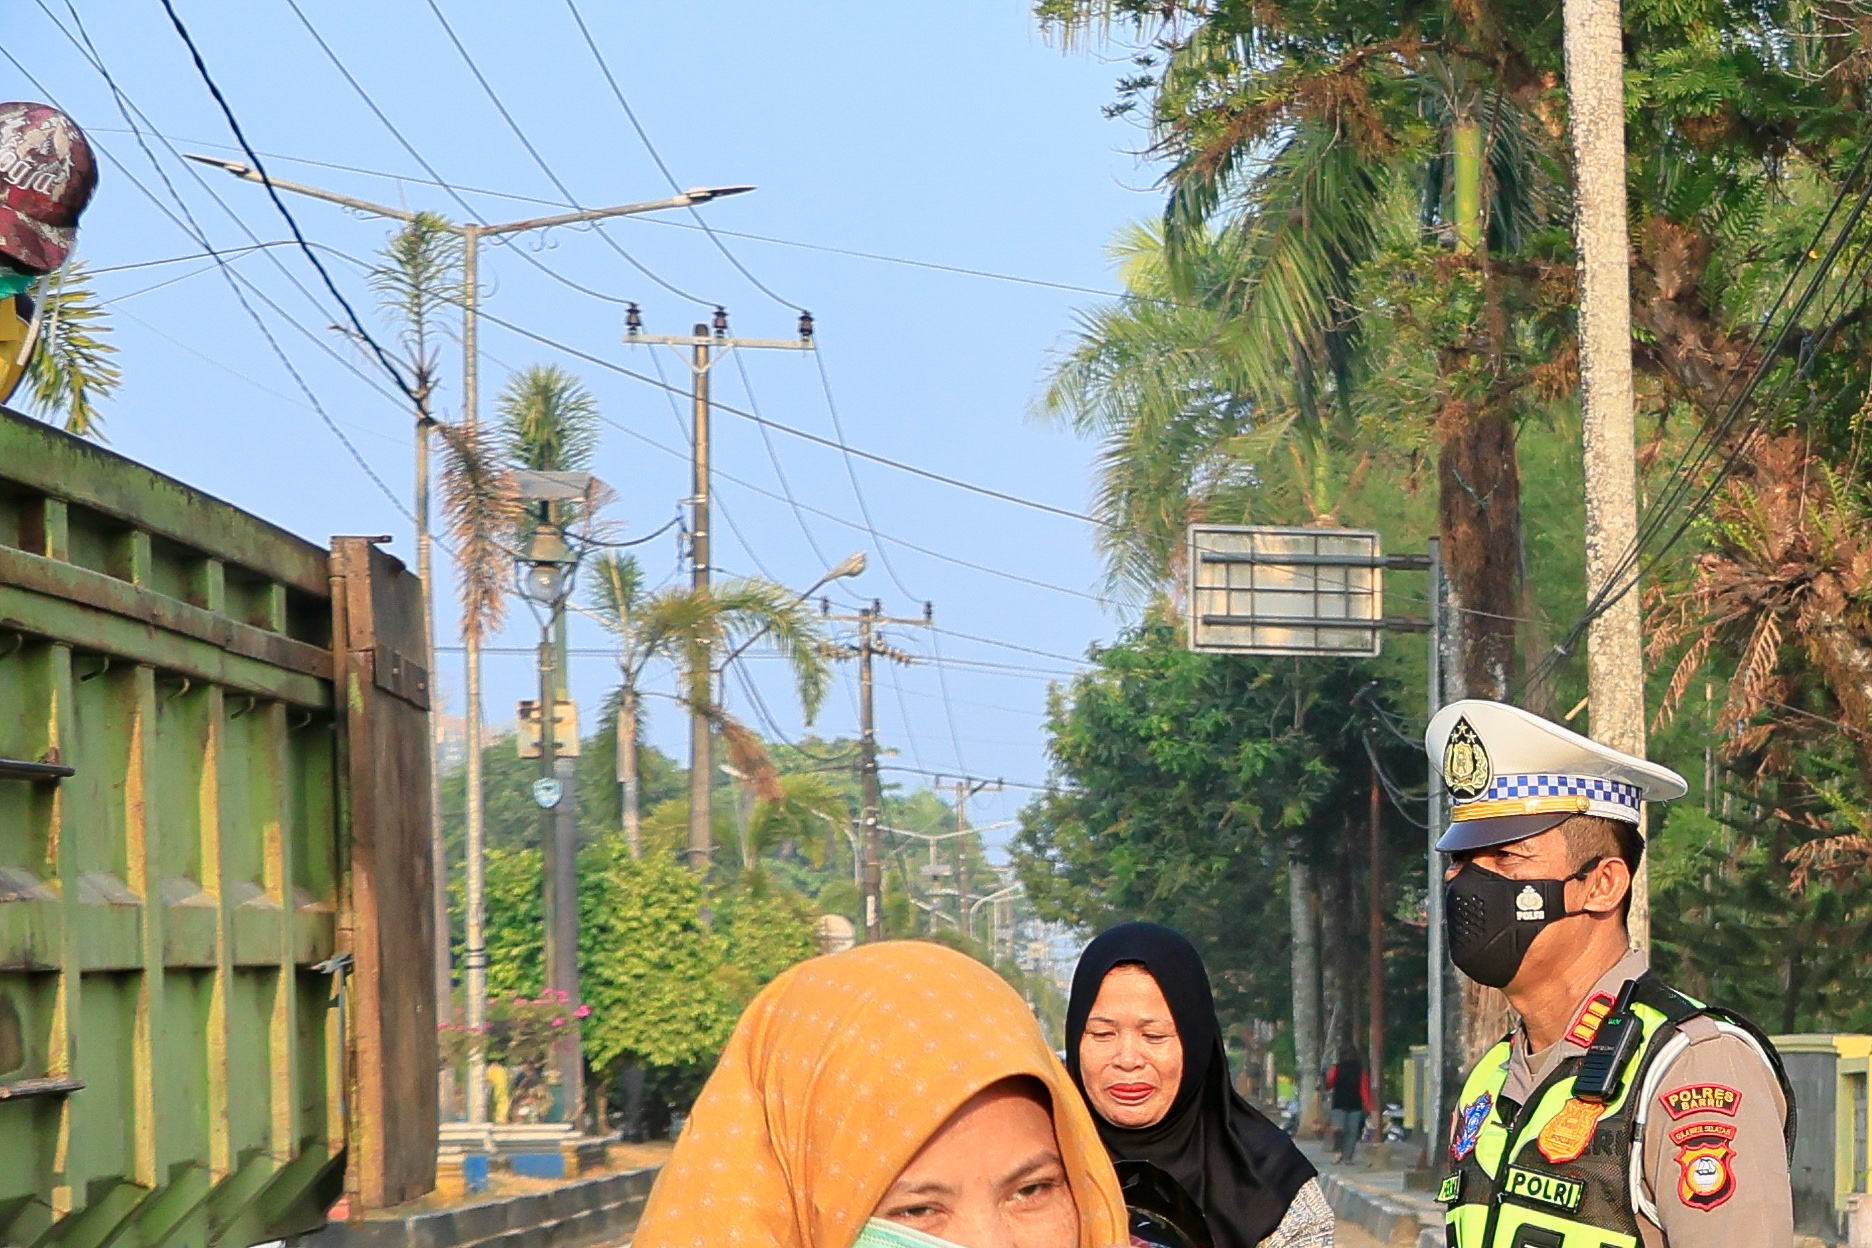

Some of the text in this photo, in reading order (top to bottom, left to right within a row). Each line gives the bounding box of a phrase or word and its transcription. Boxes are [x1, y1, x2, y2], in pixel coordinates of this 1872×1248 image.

[1668, 1087, 1734, 1107] POLRES
[1681, 1099, 1724, 1111] BARRU
[1511, 1172, 1574, 1208] POLRI
